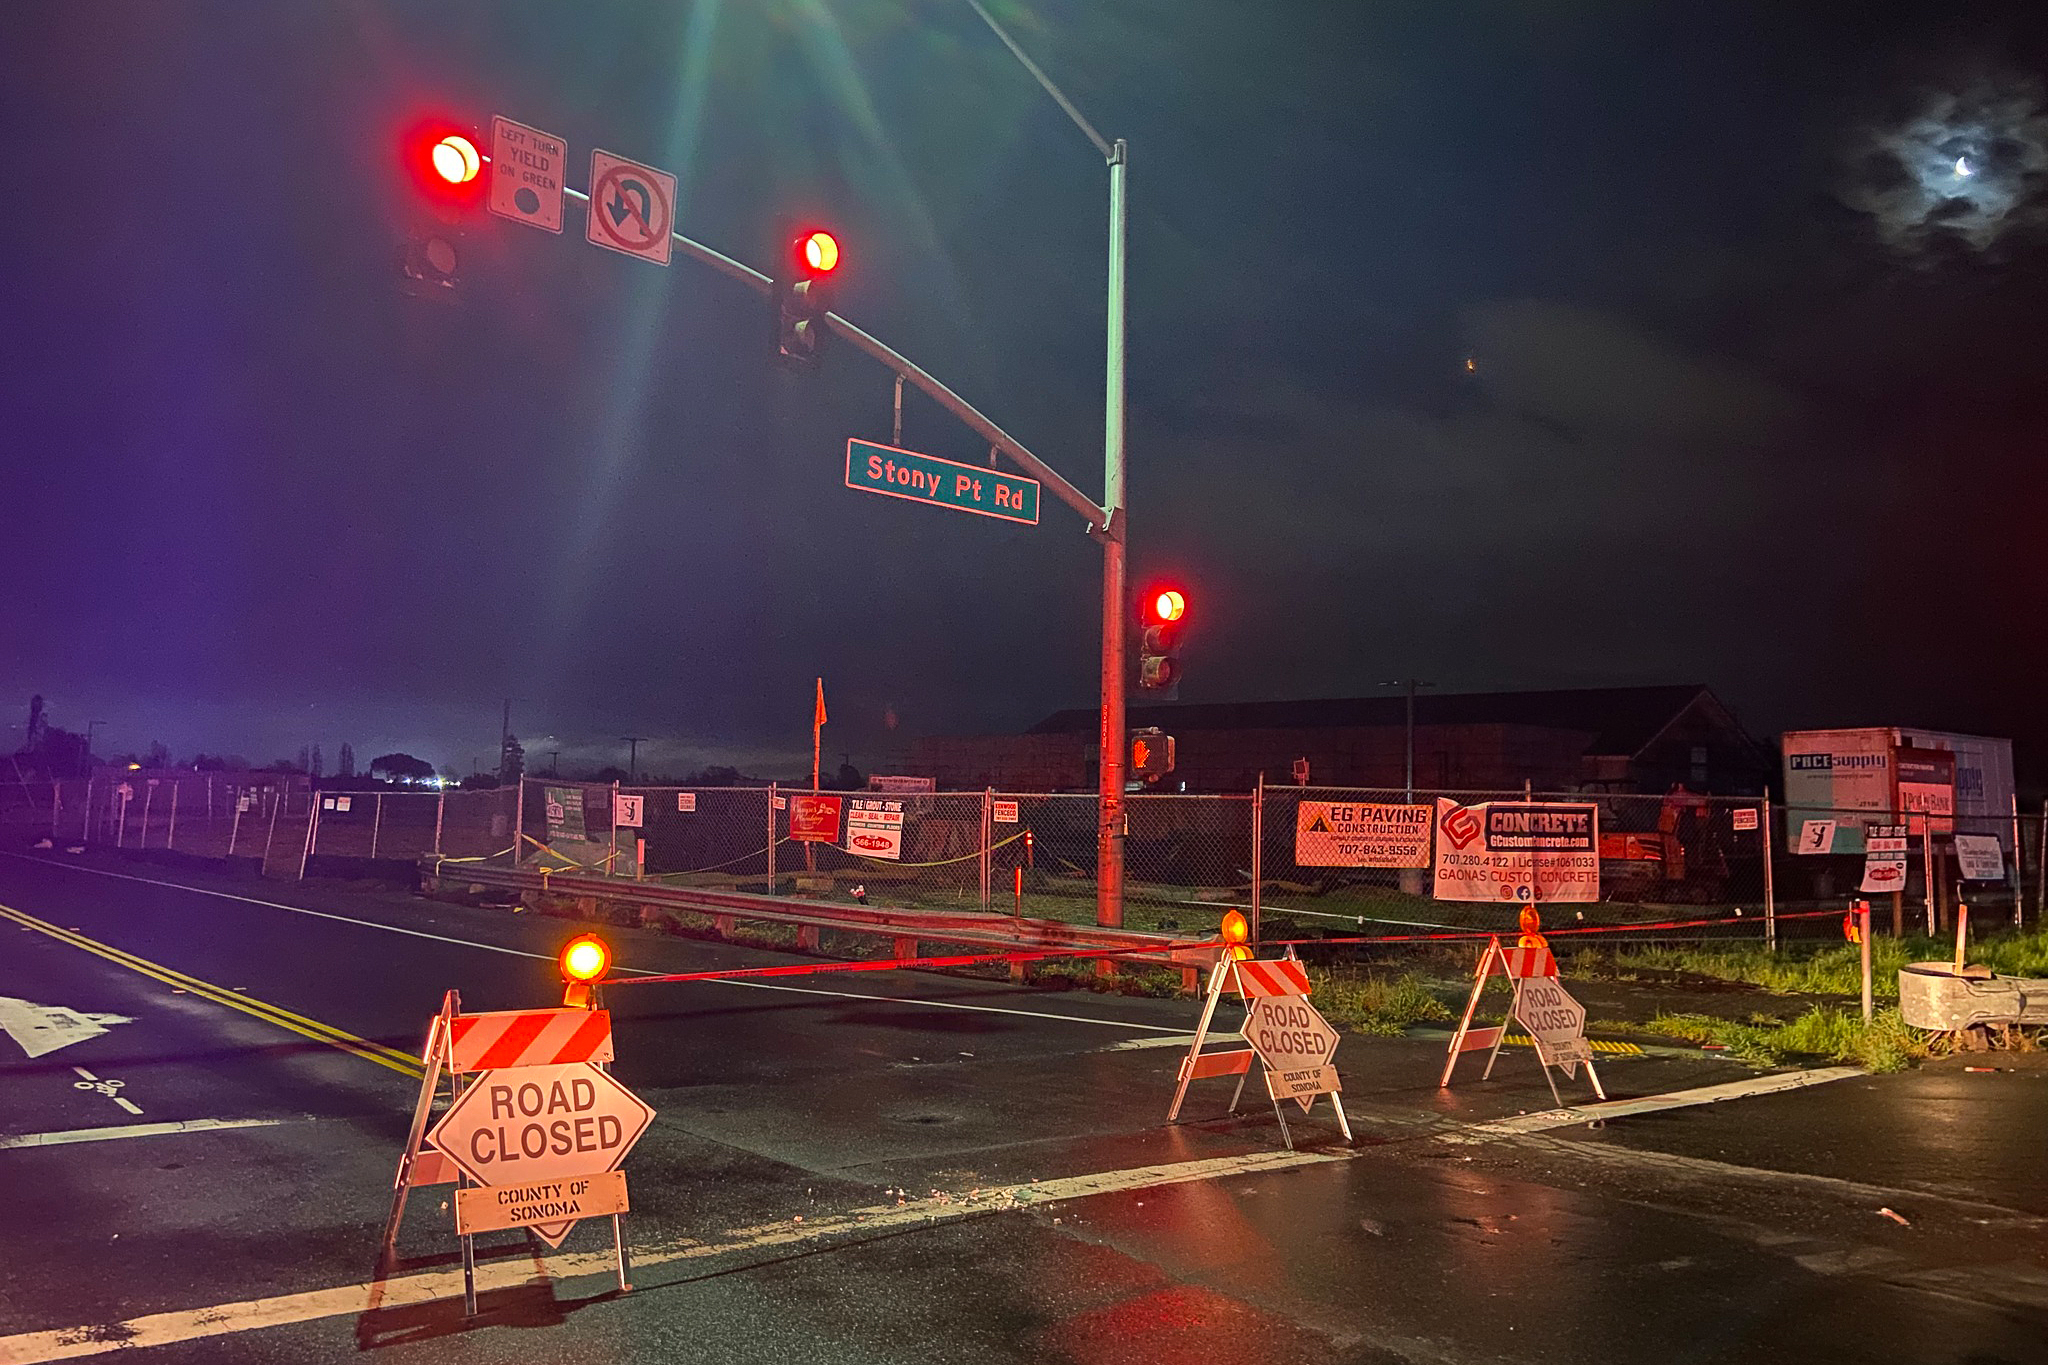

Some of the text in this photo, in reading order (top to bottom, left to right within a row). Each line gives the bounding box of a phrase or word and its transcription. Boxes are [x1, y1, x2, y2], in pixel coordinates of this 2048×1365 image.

[501, 126, 559, 156] LEFT TURN
[511, 146, 549, 171] YIELD
[500, 163, 556, 190] ON GREEN
[866, 455, 1023, 510] Stony Pt Rd
[1791, 755, 1831, 768] PACE
[1832, 754, 1886, 769] supply
[852, 799, 864, 810] TILE
[866, 800, 883, 811] GROUT
[885, 801, 903, 811] STONE
[1331, 806, 1427, 824] EG PAVING
[850, 811, 864, 819] CLEAN
[868, 812, 879, 820] SEAL
[884, 813, 900, 821] REPAIR
[1490, 812, 1588, 833] CONCRETE
[1337, 823, 1419, 835] CONSTRUCTION
[855, 838, 890, 849] 566-1948
[1338, 844, 1417, 856] 707-843-9558
[1438, 868, 1487, 882] GAONAS
[1541, 871, 1598, 883] CONCRETE
[1525, 987, 1562, 1008] ROAD
[1262, 1003, 1310, 1028] ROAD
[1528, 1008, 1577, 1032] CLOSED
[1260, 1029, 1326, 1055] CLOSED
[1283, 1069, 1321, 1082] COUNTY OF
[1291, 1081, 1322, 1093] SONOMA
[490, 1078, 596, 1120] ROAD
[470, 1115, 623, 1164] CLOSED
[497, 1180, 590, 1206] COUNTY OF
[510, 1200, 581, 1222] SONOMA
